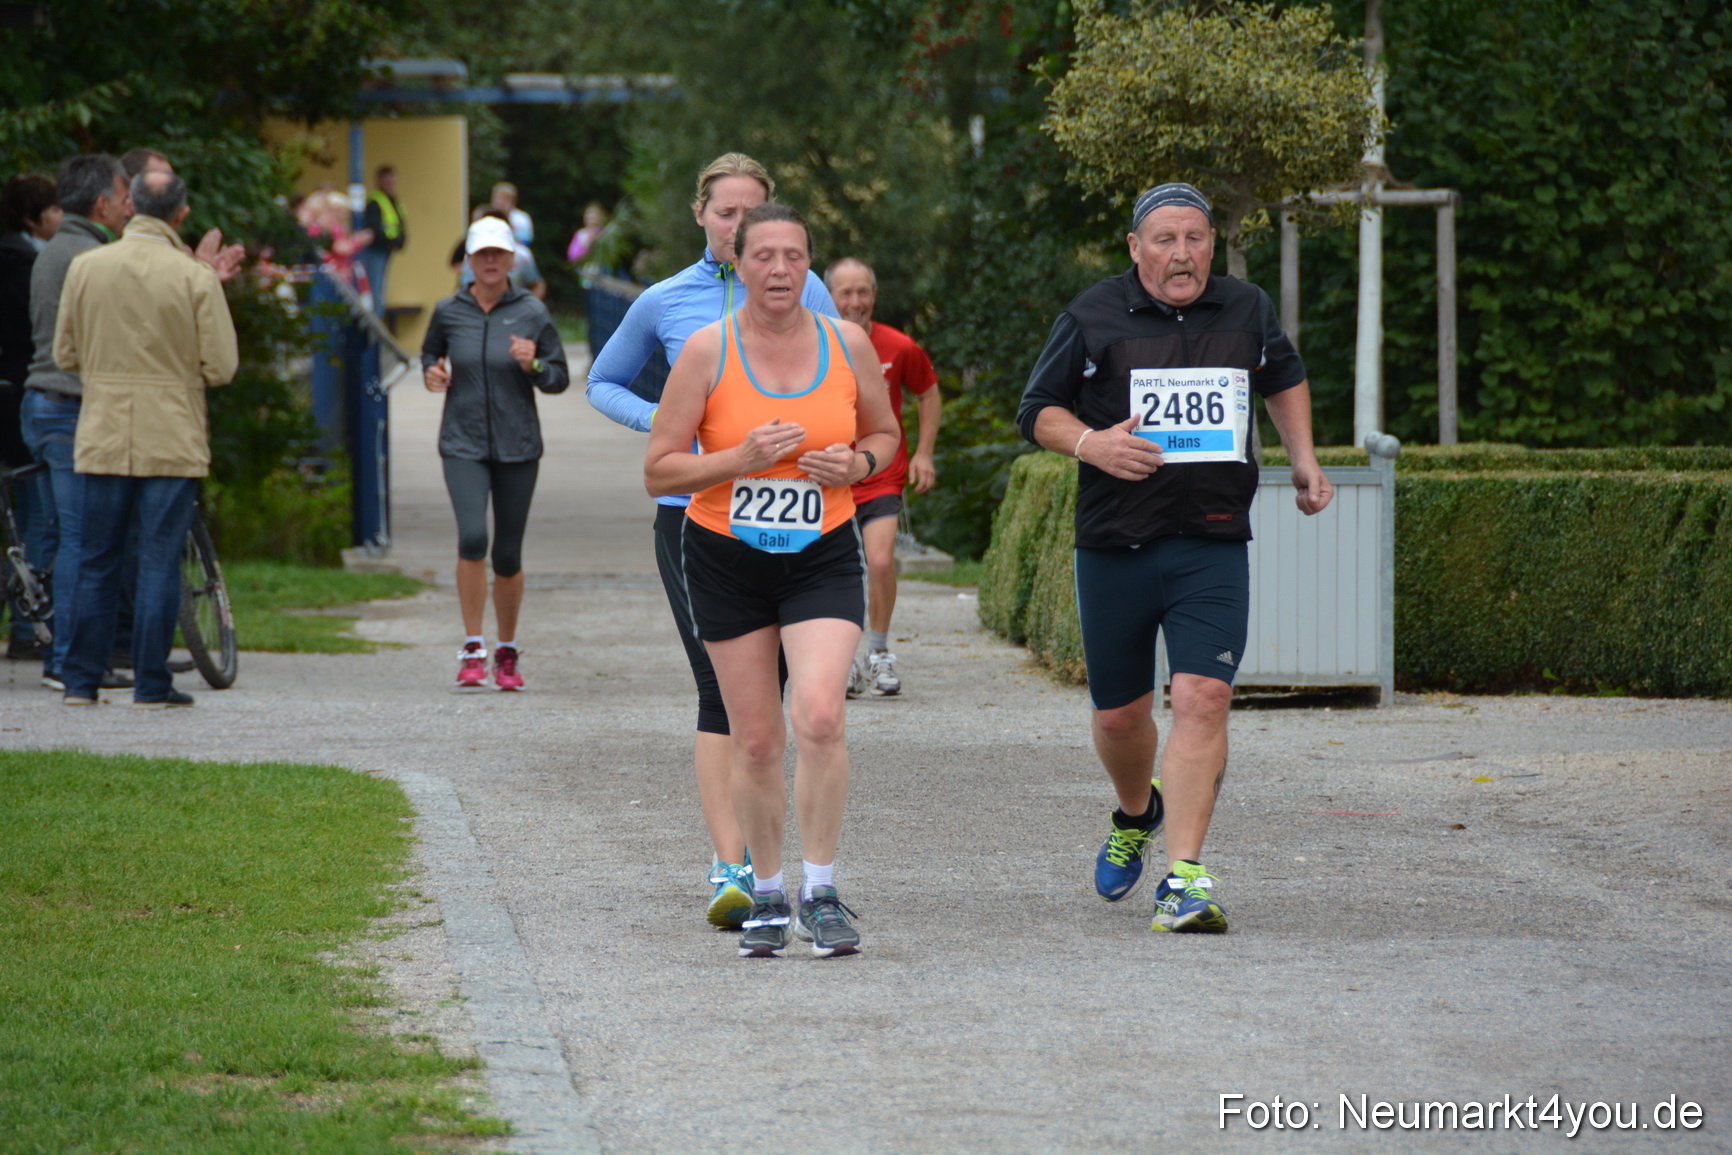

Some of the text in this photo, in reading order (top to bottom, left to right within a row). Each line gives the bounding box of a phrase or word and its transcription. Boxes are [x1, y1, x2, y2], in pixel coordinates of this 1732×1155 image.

[1133, 378, 1214, 388] PARTL Neumarkt
[1142, 391, 1225, 426] 2486
[1167, 435, 1201, 449] Hans
[732, 486, 821, 524] 2220
[759, 532, 790, 547] Gabi
